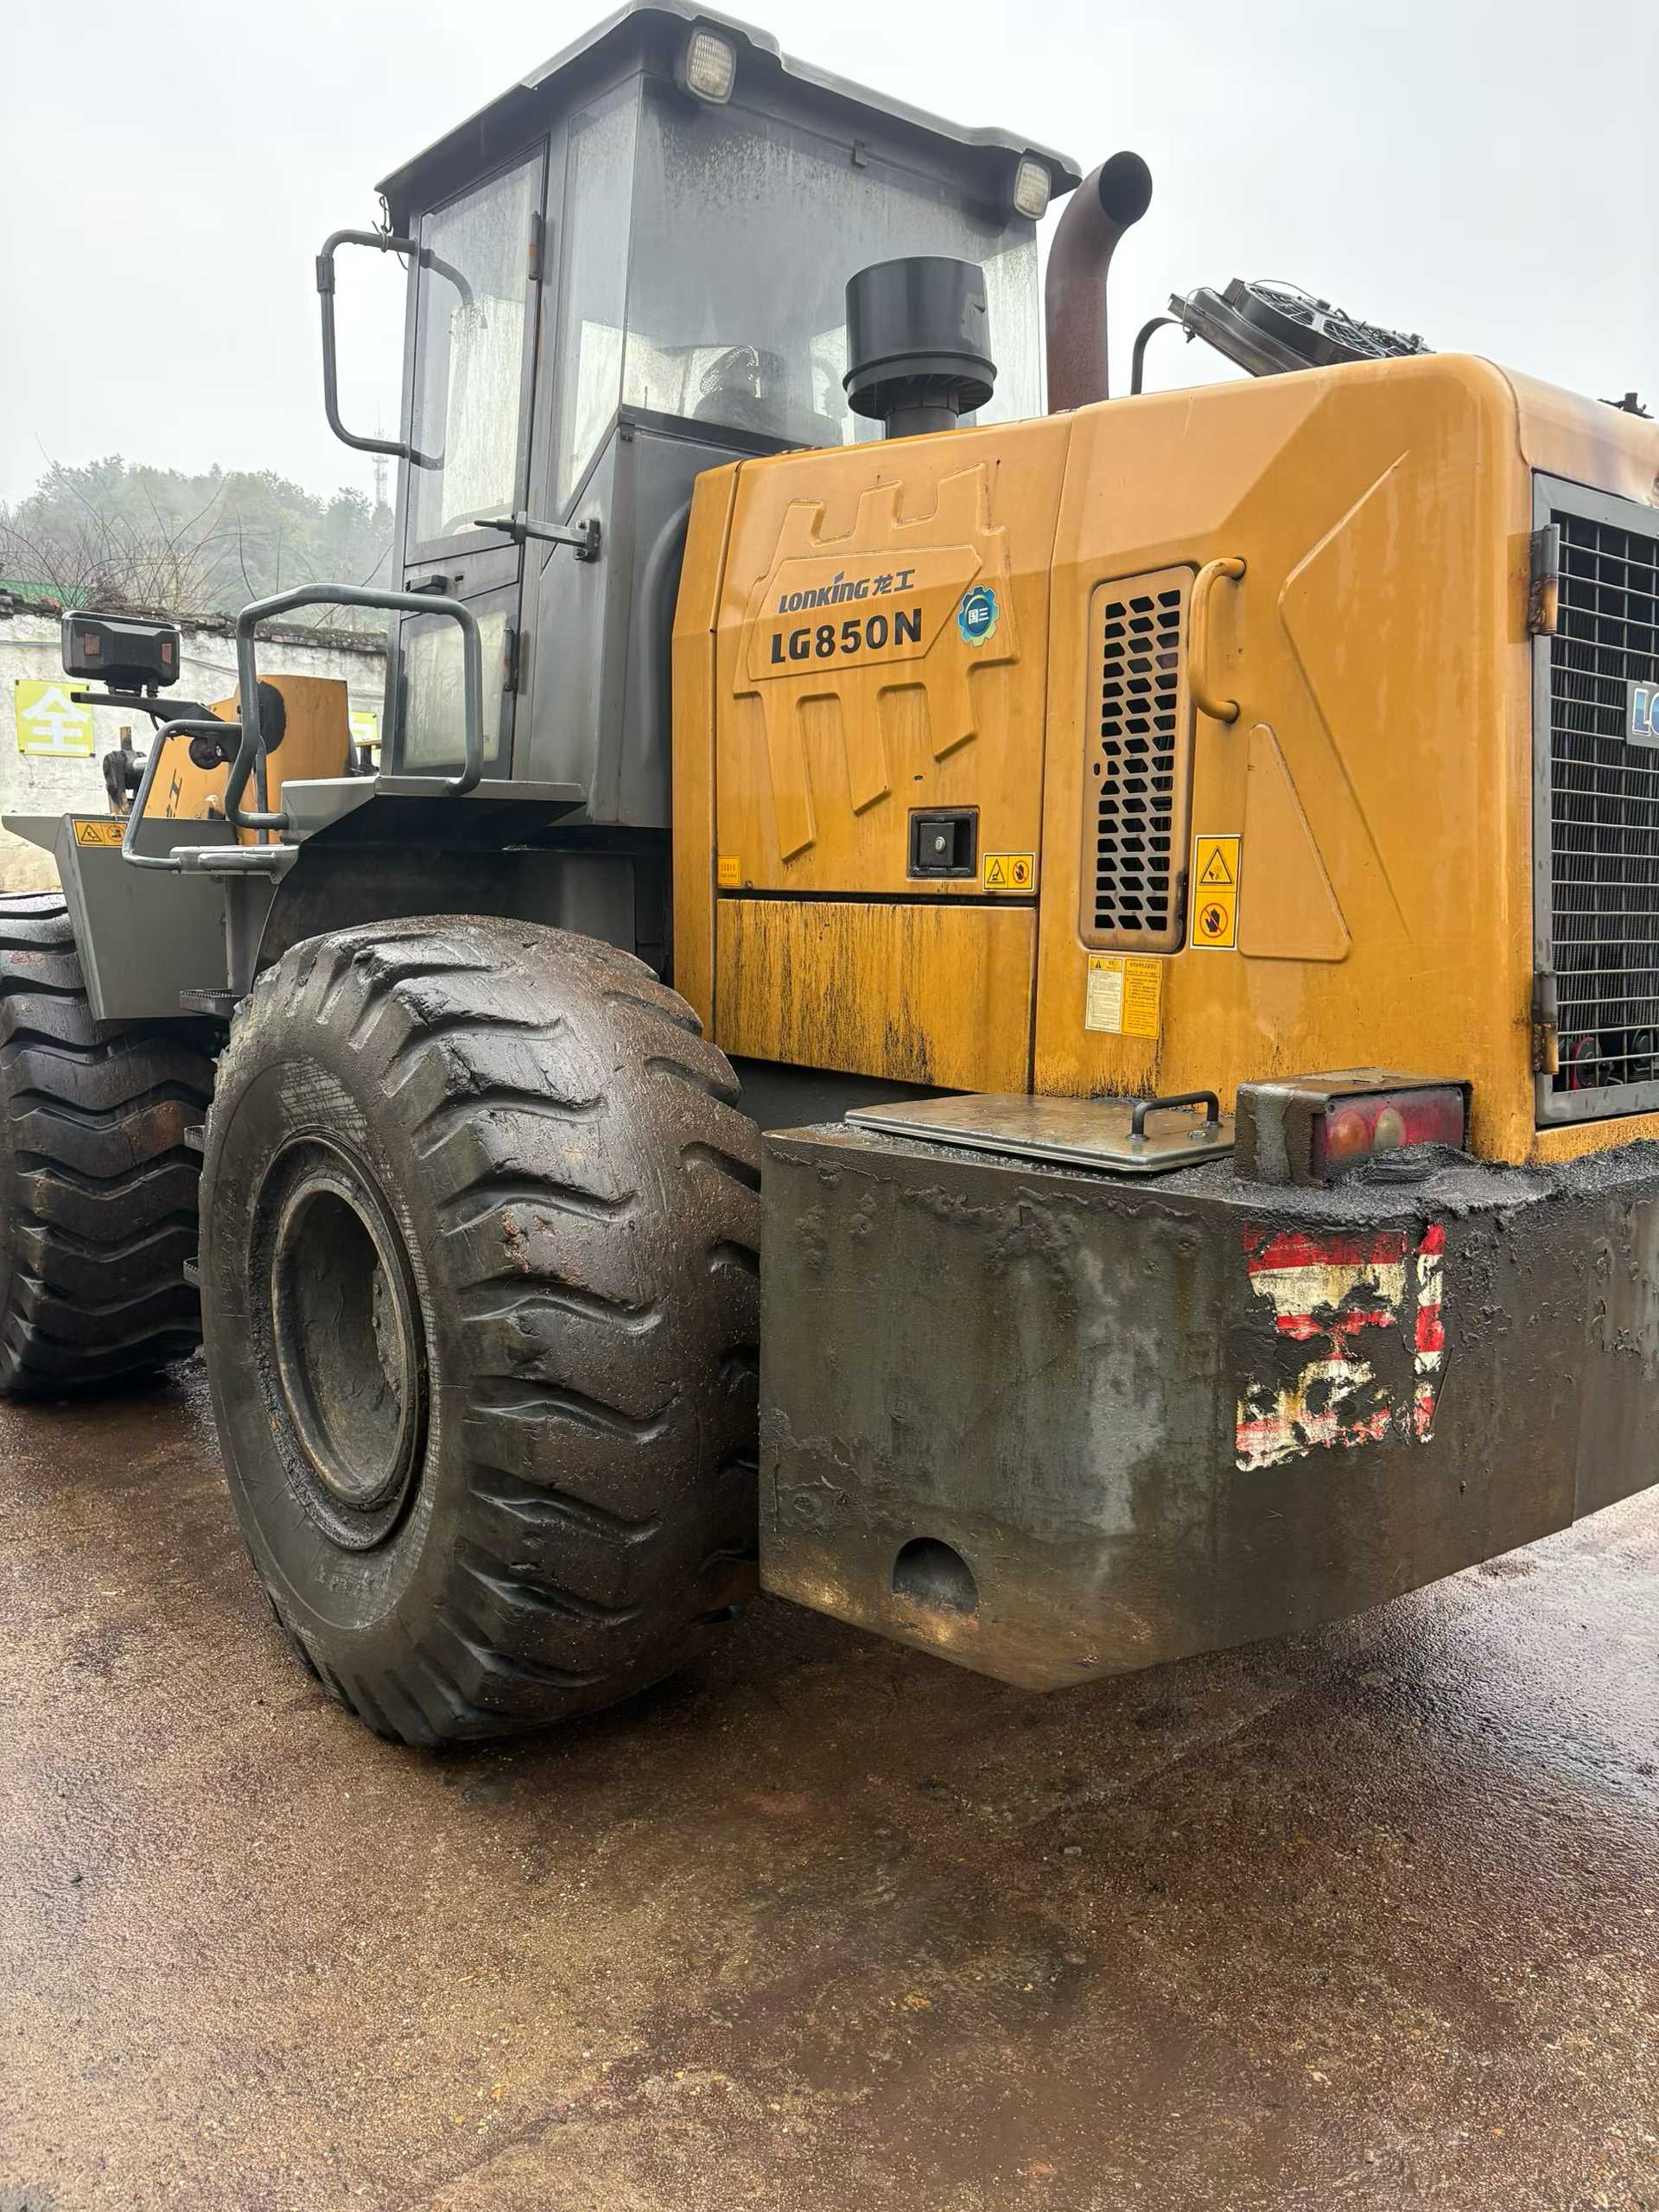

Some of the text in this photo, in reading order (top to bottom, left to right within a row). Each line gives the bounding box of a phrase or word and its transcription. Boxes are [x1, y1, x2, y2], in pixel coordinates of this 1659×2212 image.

[872, 569, 916, 595] 龙工
[771, 607, 922, 664] LG850N
[22, 686, 88, 753] 全
